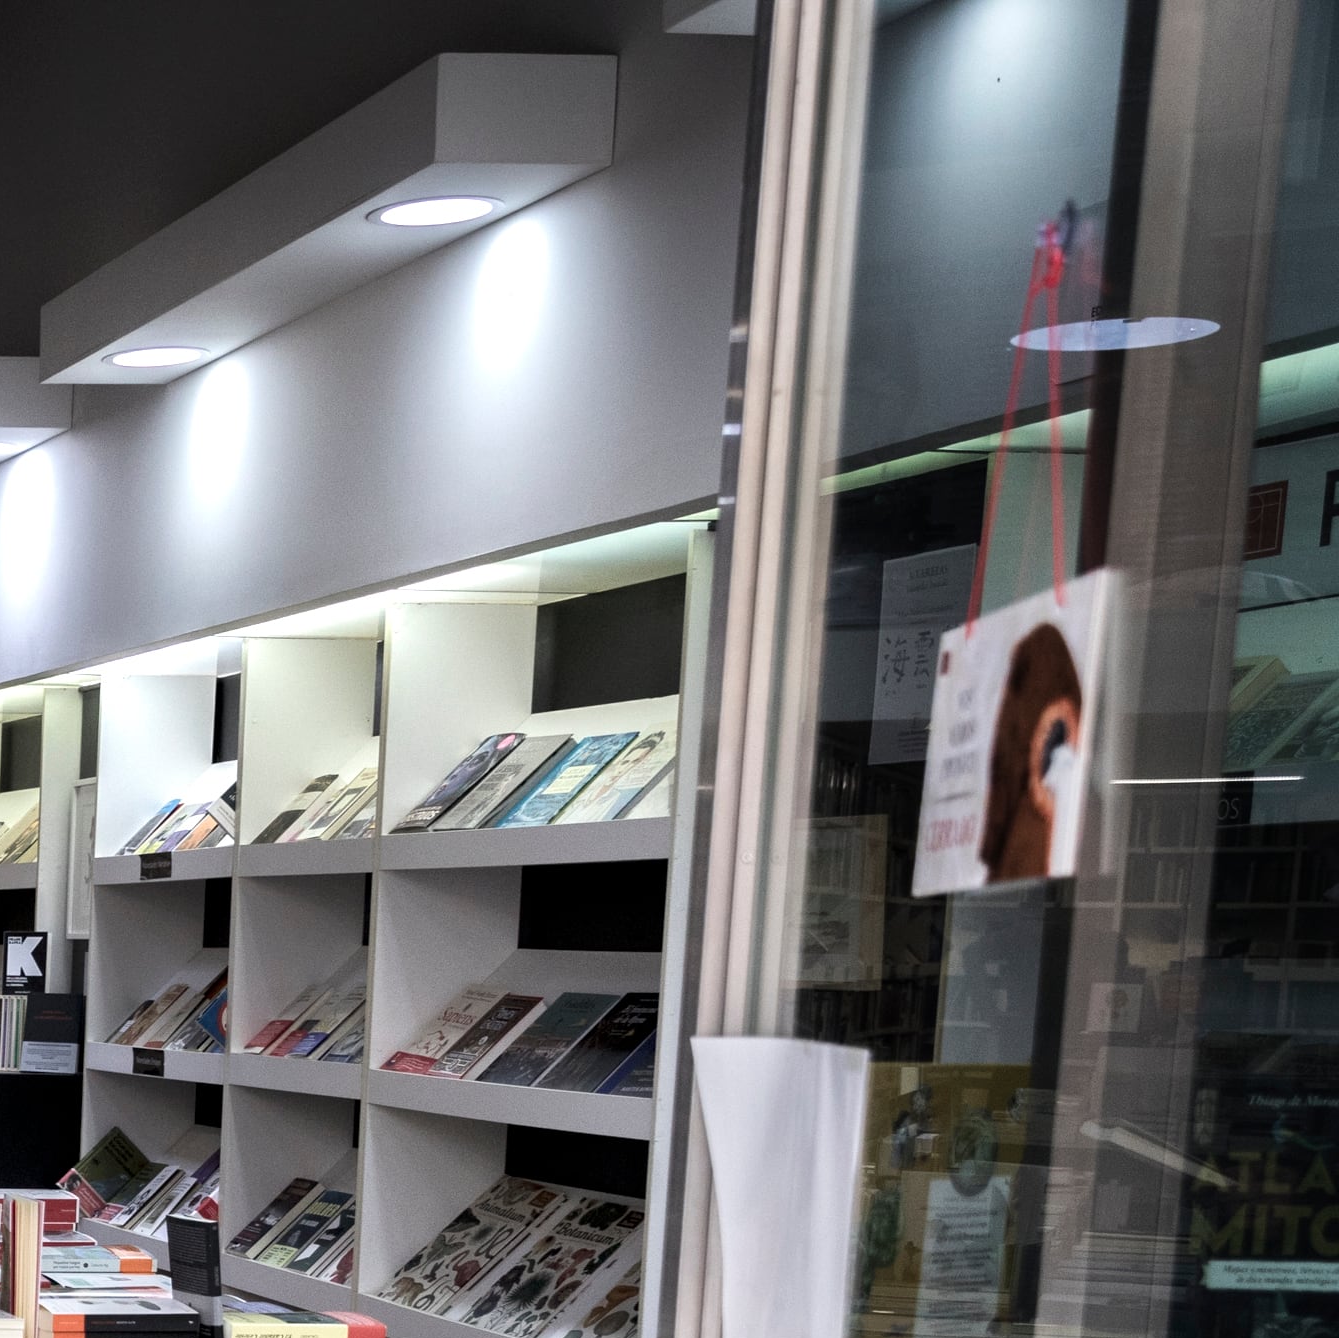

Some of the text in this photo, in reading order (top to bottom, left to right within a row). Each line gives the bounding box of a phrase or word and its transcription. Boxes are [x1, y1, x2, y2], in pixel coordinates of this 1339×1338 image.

[7, 936, 44, 977] K
[437, 1006, 475, 1026] Sapiens
[1191, 1151, 1337, 1194] ATLA
[475, 1200, 526, 1222] Animalium
[557, 1223, 615, 1245] Botanicum
